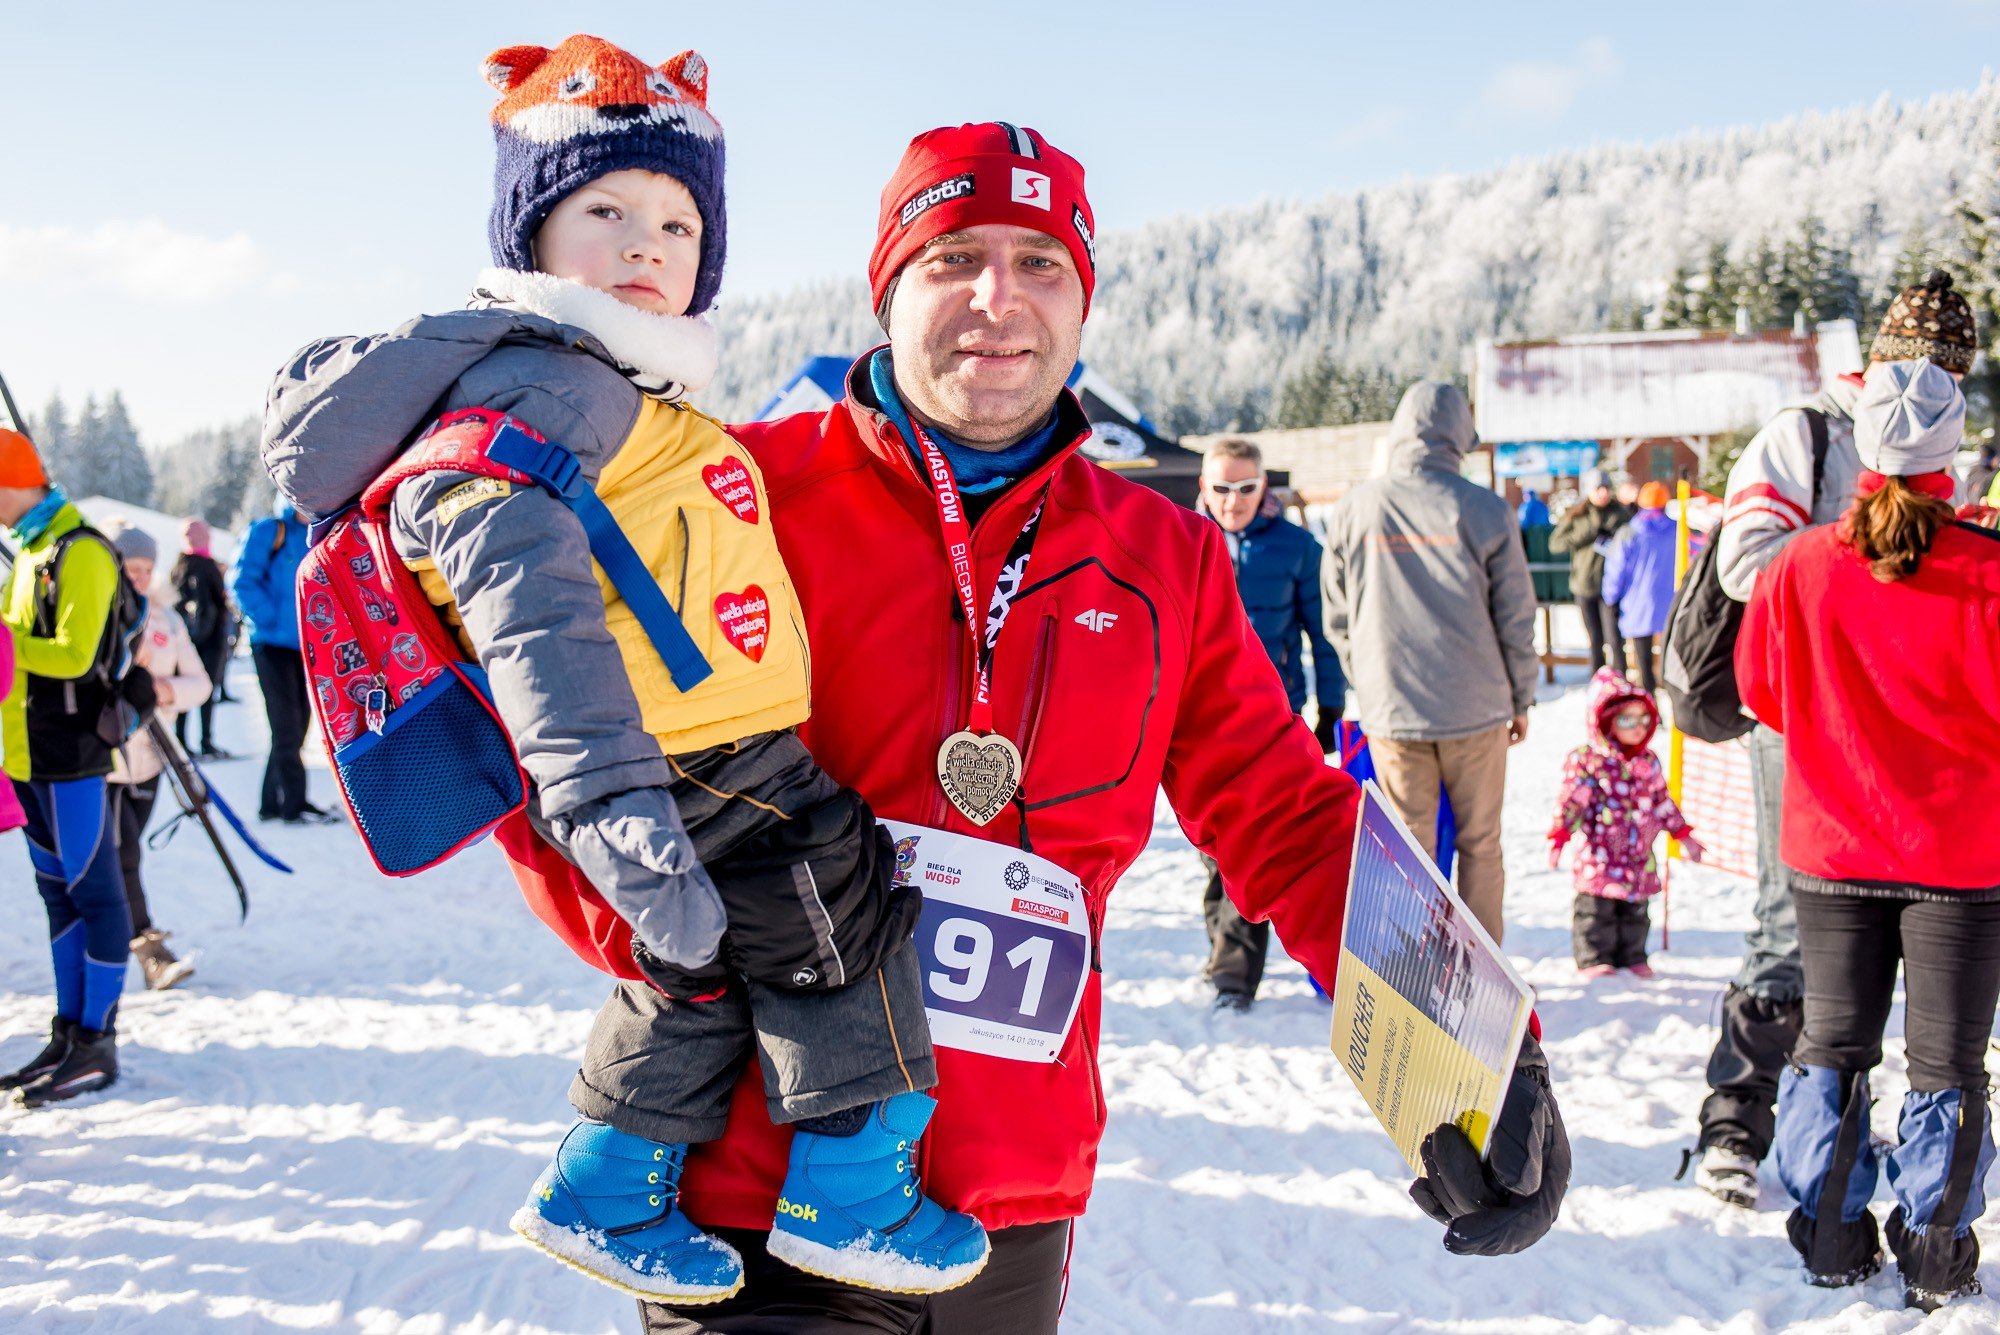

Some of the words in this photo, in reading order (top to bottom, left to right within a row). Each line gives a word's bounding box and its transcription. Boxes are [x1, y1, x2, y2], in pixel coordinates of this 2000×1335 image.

[902, 179, 971, 226] Eisbär
[351, 554, 372, 573] 95
[1074, 608, 1118, 633] 4F
[940, 773, 977, 819] BIEGNIJ
[981, 806, 1000, 822] DLA
[925, 870, 961, 885] WOŚP
[926, 862, 945, 871] BIEG
[946, 866, 962, 875] DLA
[1018, 900, 1065, 919] DATASPORT
[969, 1028, 1004, 1040] Jakuszyce
[1347, 980, 1376, 1082] VOUCHER
